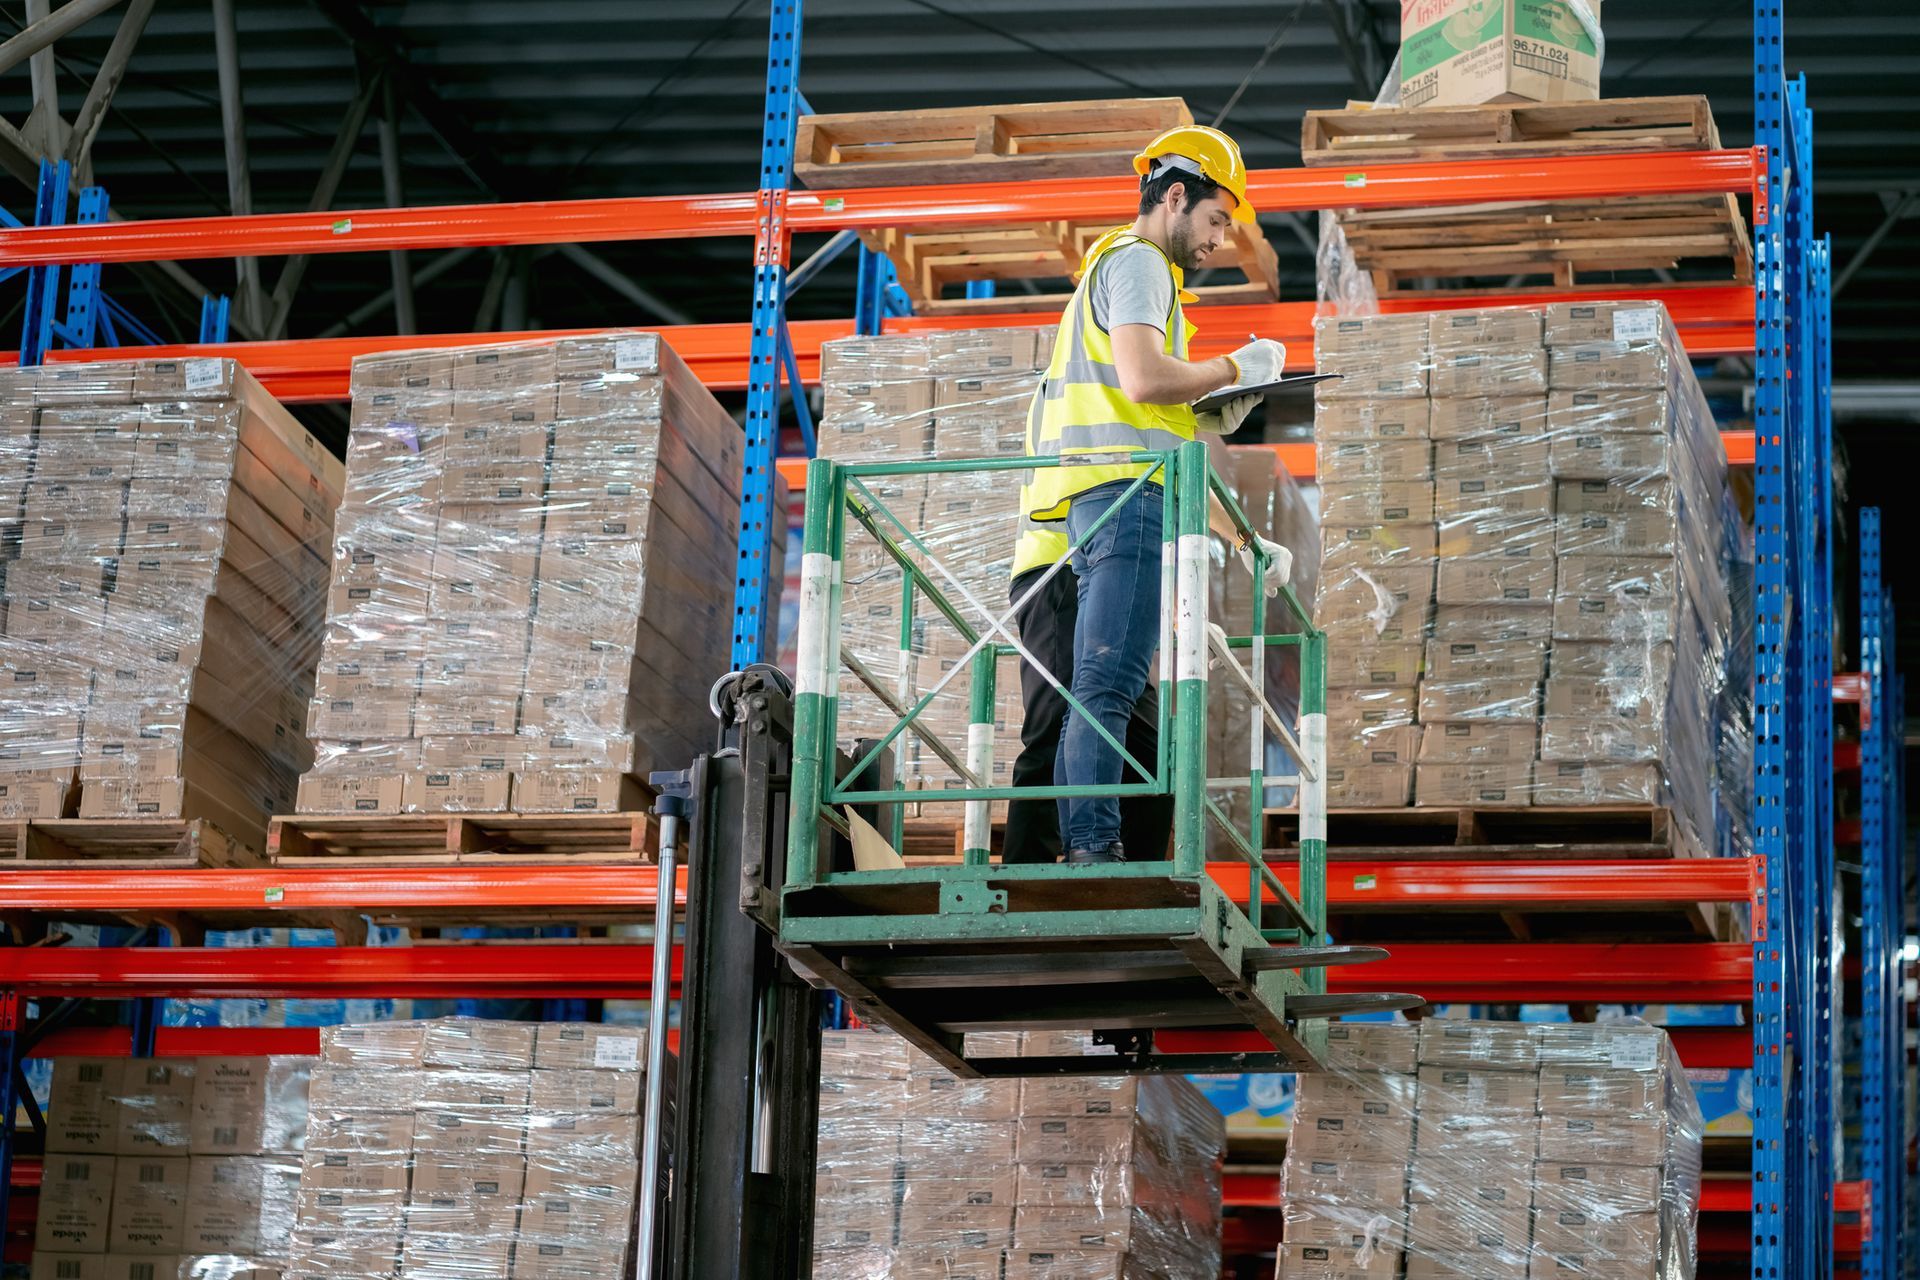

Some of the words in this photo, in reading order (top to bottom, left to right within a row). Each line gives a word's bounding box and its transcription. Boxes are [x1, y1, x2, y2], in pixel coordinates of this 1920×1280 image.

[1513, 39, 1569, 62] 96.71.024
[214, 1064, 250, 1077] vileda
[65, 1132, 100, 1144] vileda
[52, 1230, 87, 1243] vileda
[128, 1233, 163, 1246] vileda
